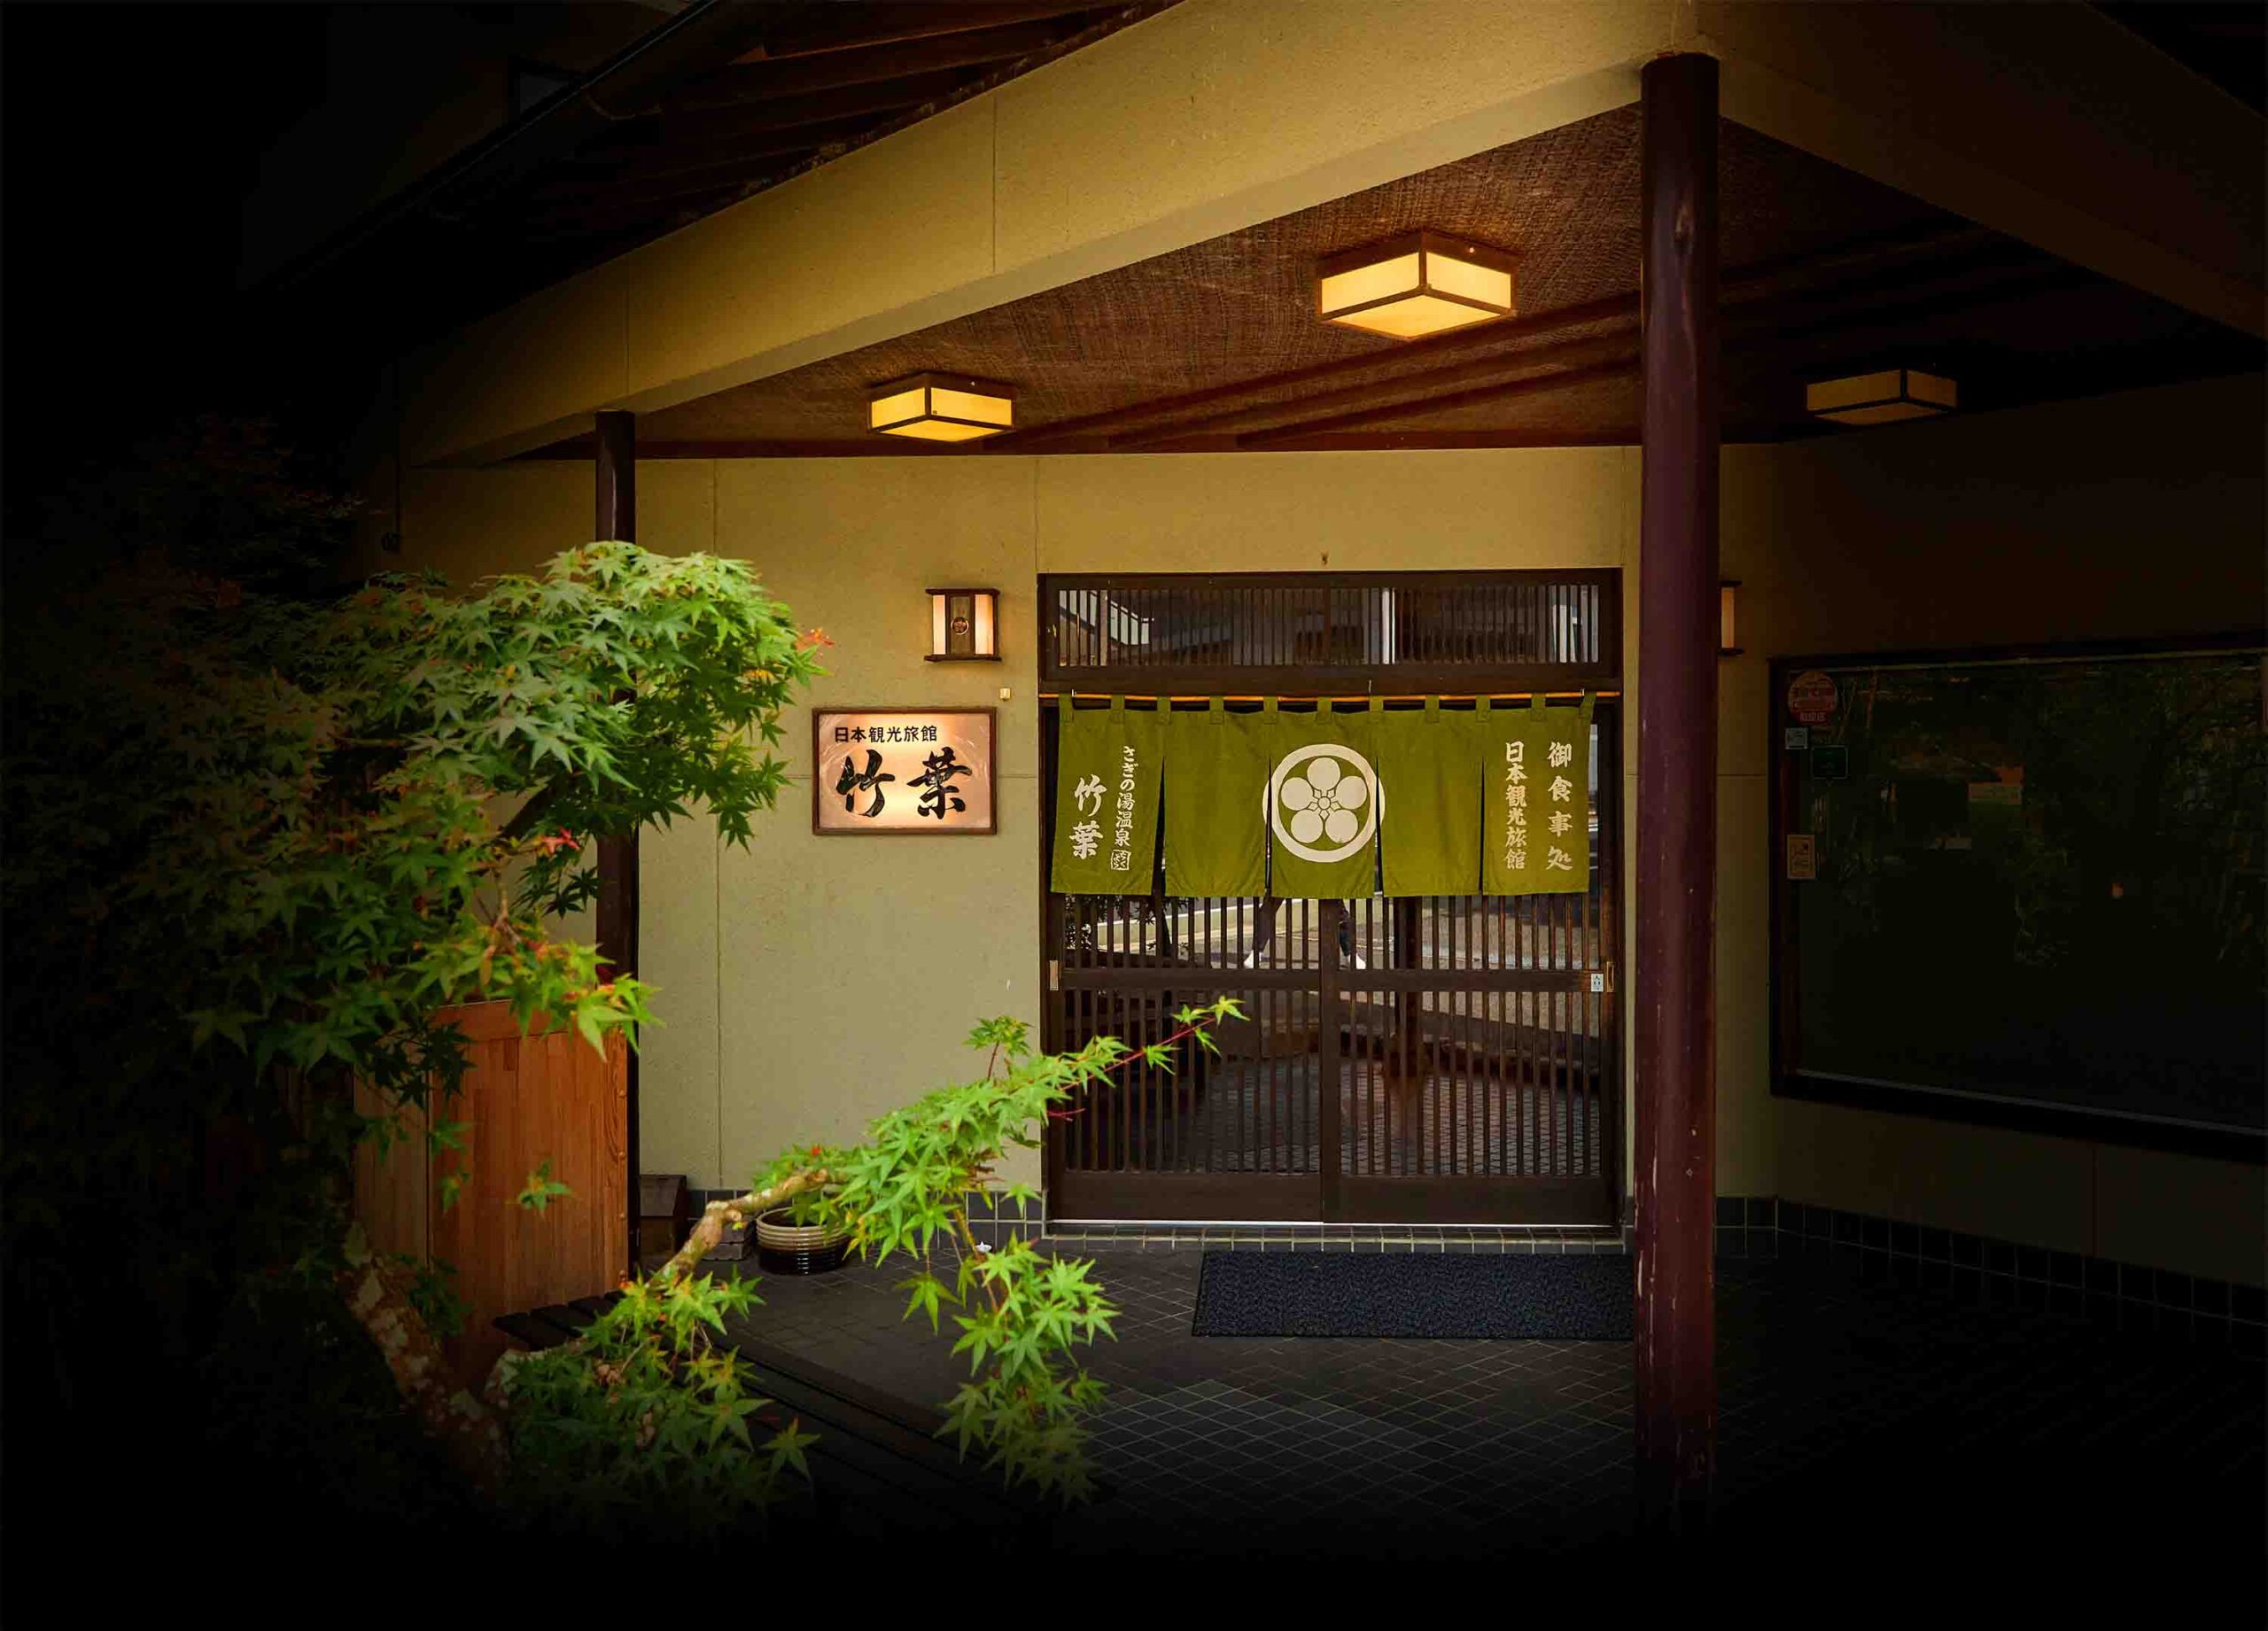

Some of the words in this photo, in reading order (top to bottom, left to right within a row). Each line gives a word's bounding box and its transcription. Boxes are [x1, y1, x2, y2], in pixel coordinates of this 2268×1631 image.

[835, 725, 937, 743] 日本観光旅館
[835, 746, 973, 819] 竹葉
[1068, 773, 1107, 860] 竹葉
[1115, 745, 1139, 847] さぎの湯温泉
[1505, 741, 1528, 870] 日本観光旅館
[1546, 742, 1573, 871] 御食事処
